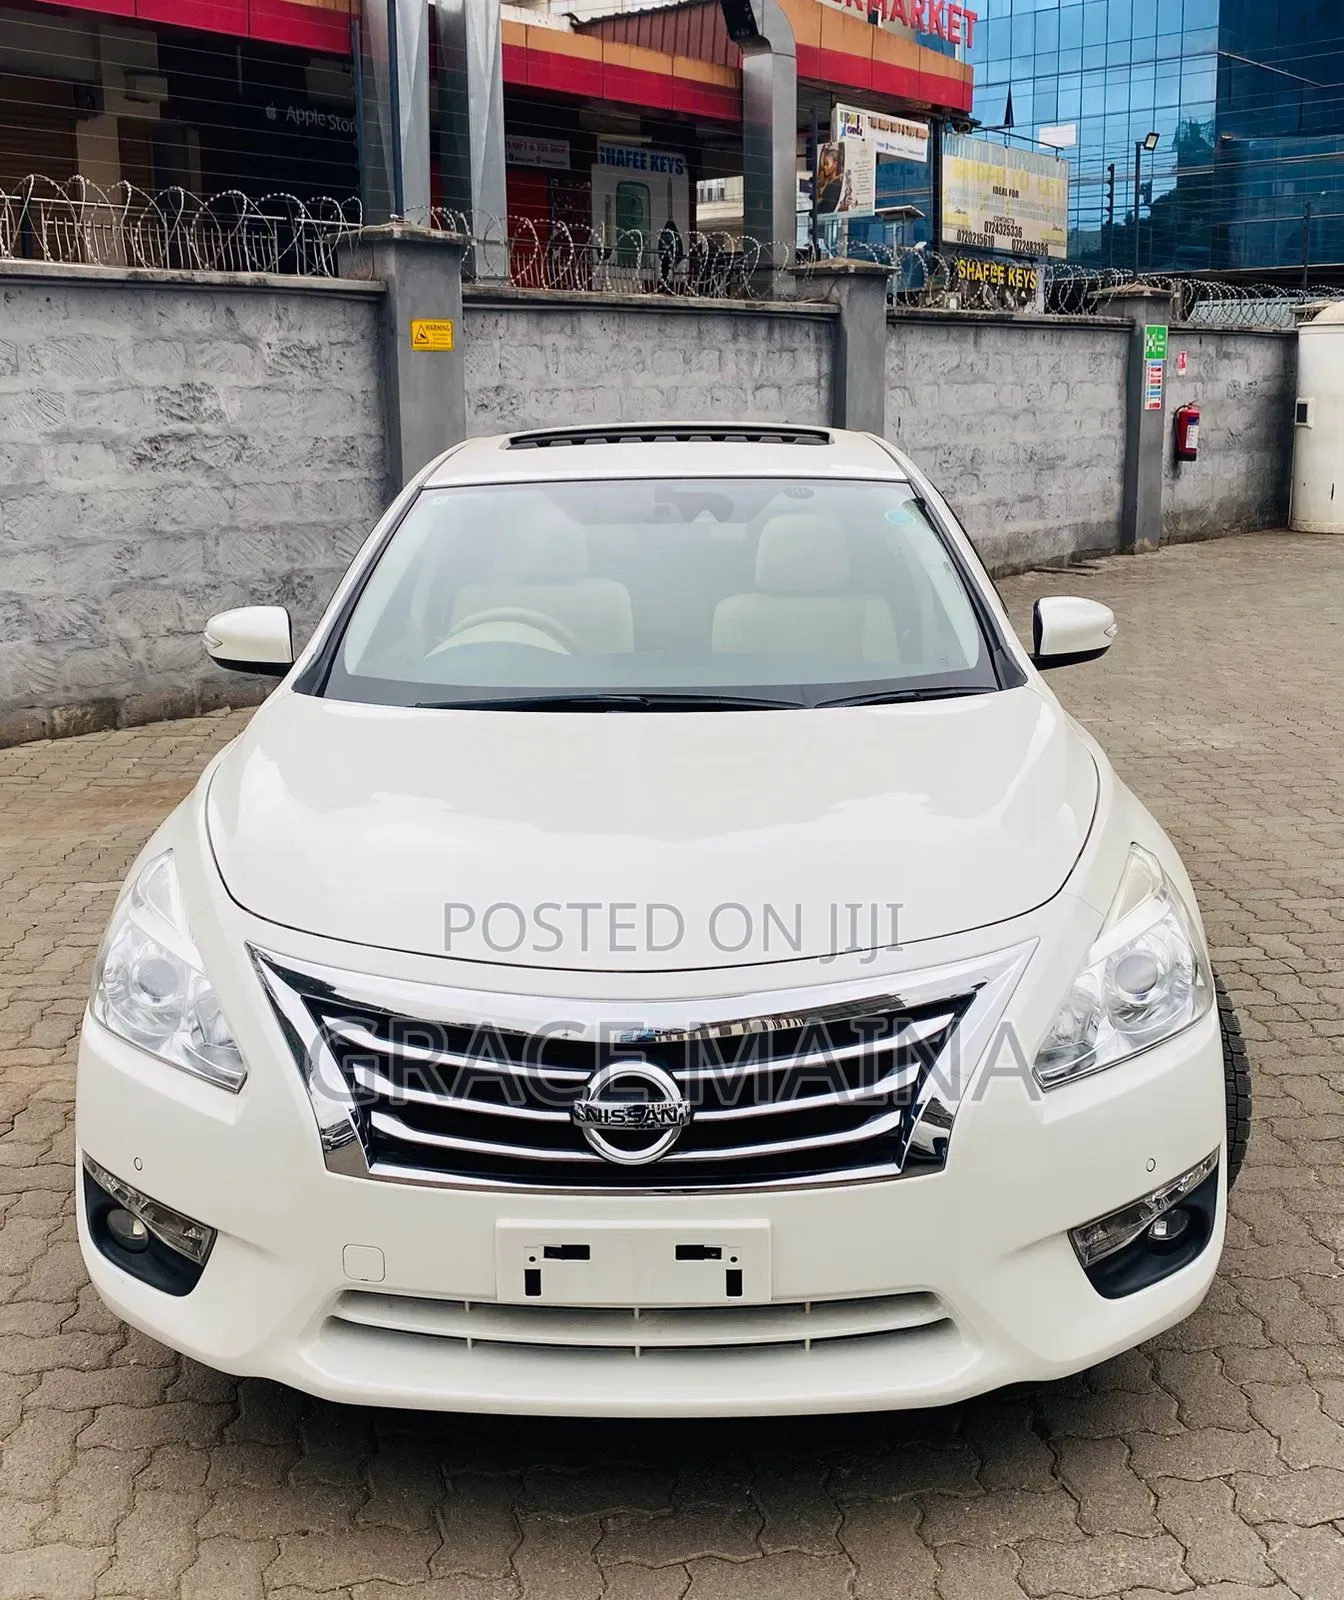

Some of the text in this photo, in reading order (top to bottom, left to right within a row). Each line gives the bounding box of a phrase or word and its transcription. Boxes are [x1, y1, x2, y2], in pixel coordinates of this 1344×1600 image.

[832, 0, 977, 48] MARKET
[286, 105, 326, 126] Apple
[650, 154, 684, 176] KEYS
[1009, 189, 1020, 199] FOR
[1008, 267, 1037, 290] KEYS
[584, 1107, 678, 1124] NISSAN
